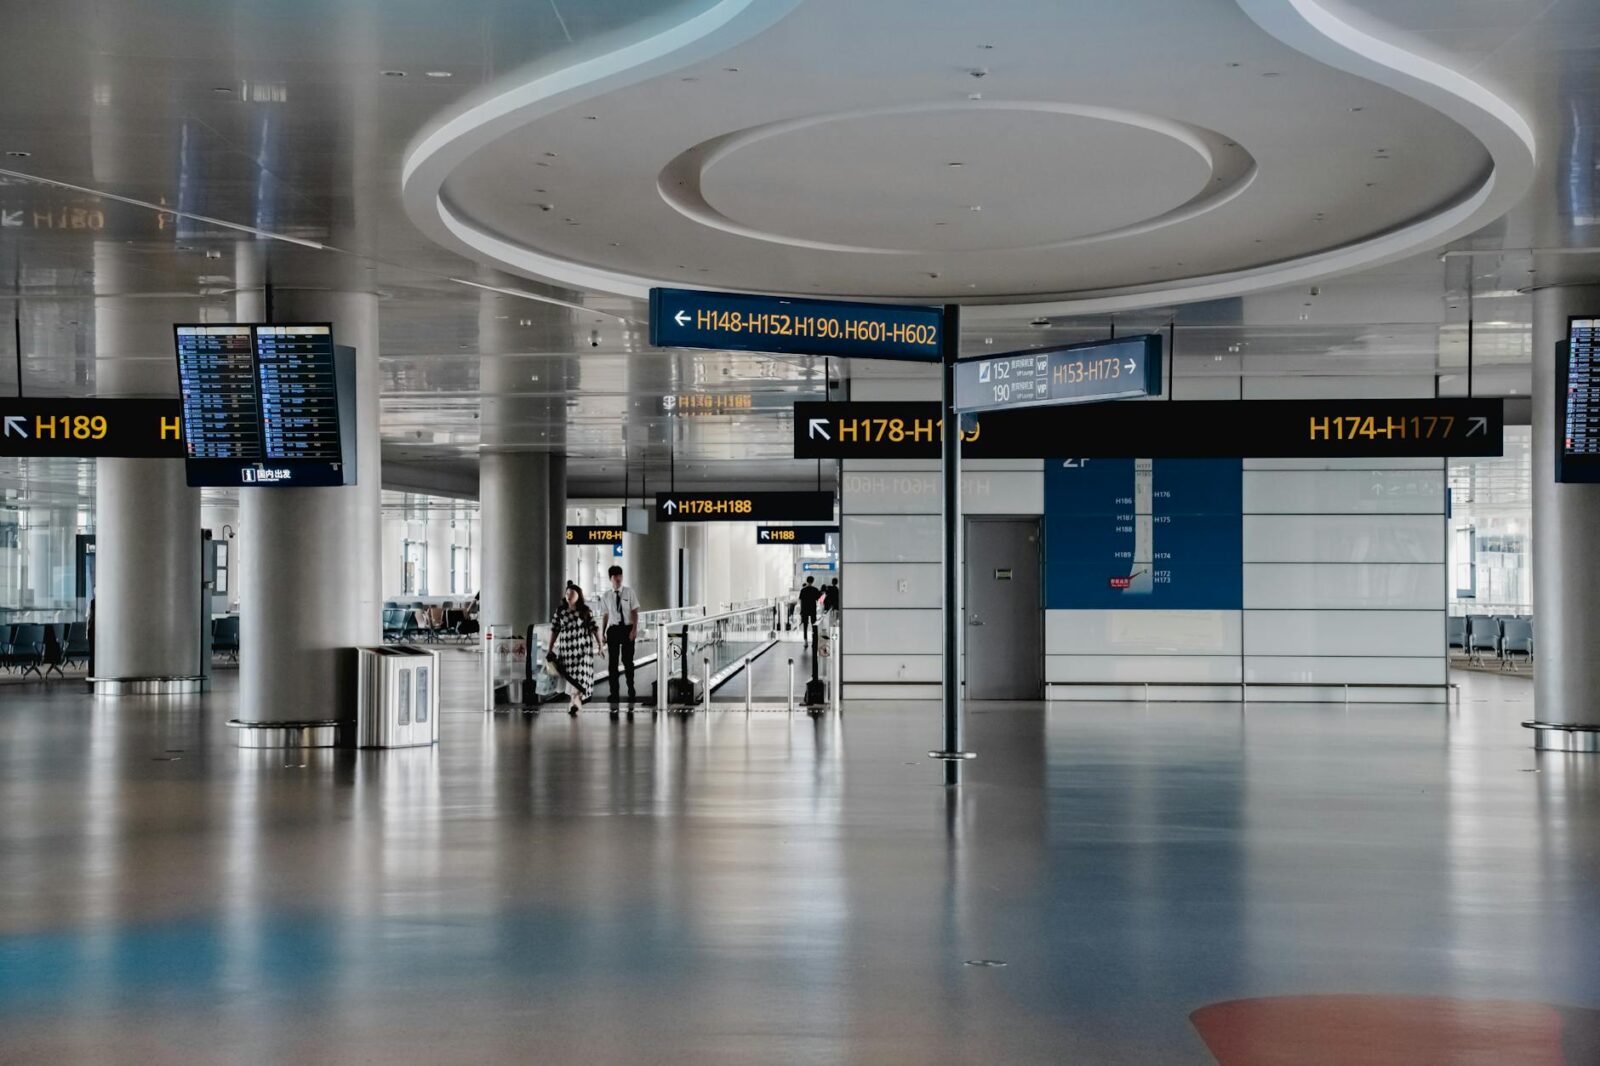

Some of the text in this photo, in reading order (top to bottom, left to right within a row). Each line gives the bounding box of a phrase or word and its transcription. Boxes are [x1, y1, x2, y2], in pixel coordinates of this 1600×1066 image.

[993, 361, 1010, 380] 152
[1053, 358, 1121, 385] H153-H173
[993, 384, 1010, 402] 190
[36, 415, 108, 440] H189
[838, 417, 981, 443] H178-H19
[1309, 415, 1455, 441] H174-H177
[678, 499, 753, 514] H178-H188
[770, 530, 796, 541] H188
